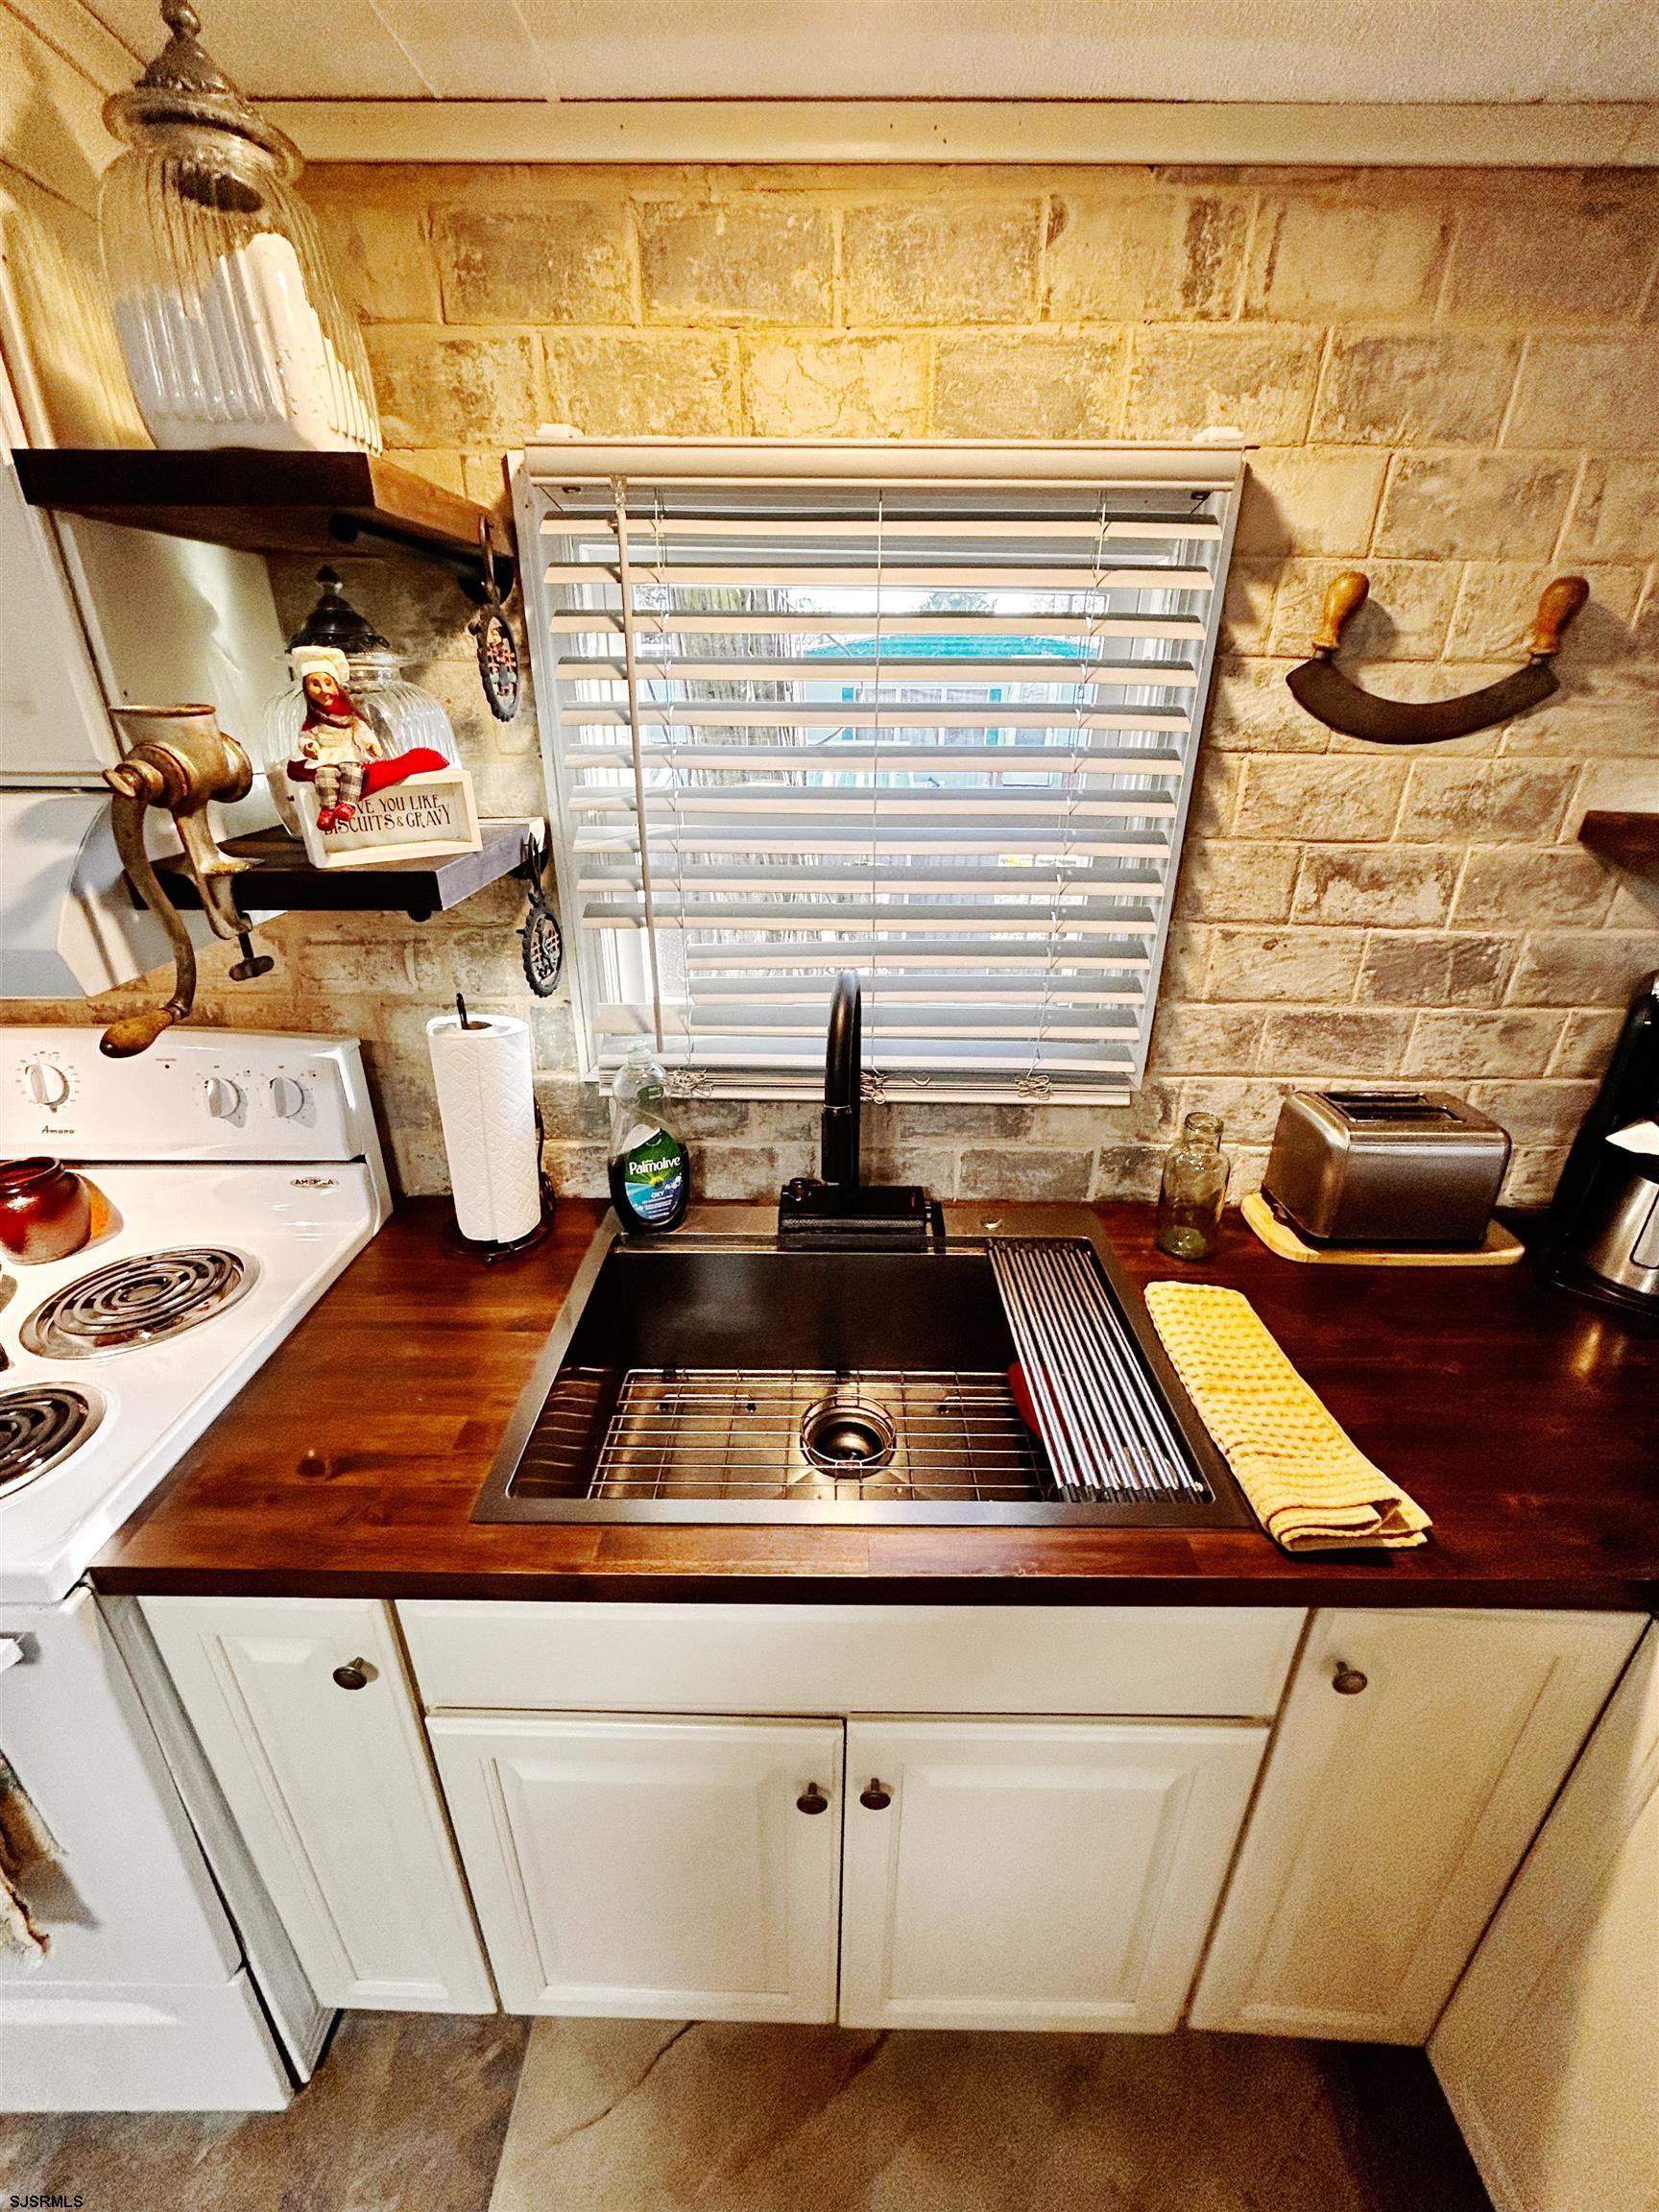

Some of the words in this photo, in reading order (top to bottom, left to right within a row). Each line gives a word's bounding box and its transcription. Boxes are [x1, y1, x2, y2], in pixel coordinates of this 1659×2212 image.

[379, 797, 405, 812] YOU
[410, 794, 441, 810] LIKE
[325, 814, 395, 834] SCUITS
[397, 816, 404, 828] &
[406, 804, 451, 829] GRAVY
[41, 1125, 75, 1134] Amana
[629, 1156, 681, 1175] Palmolive
